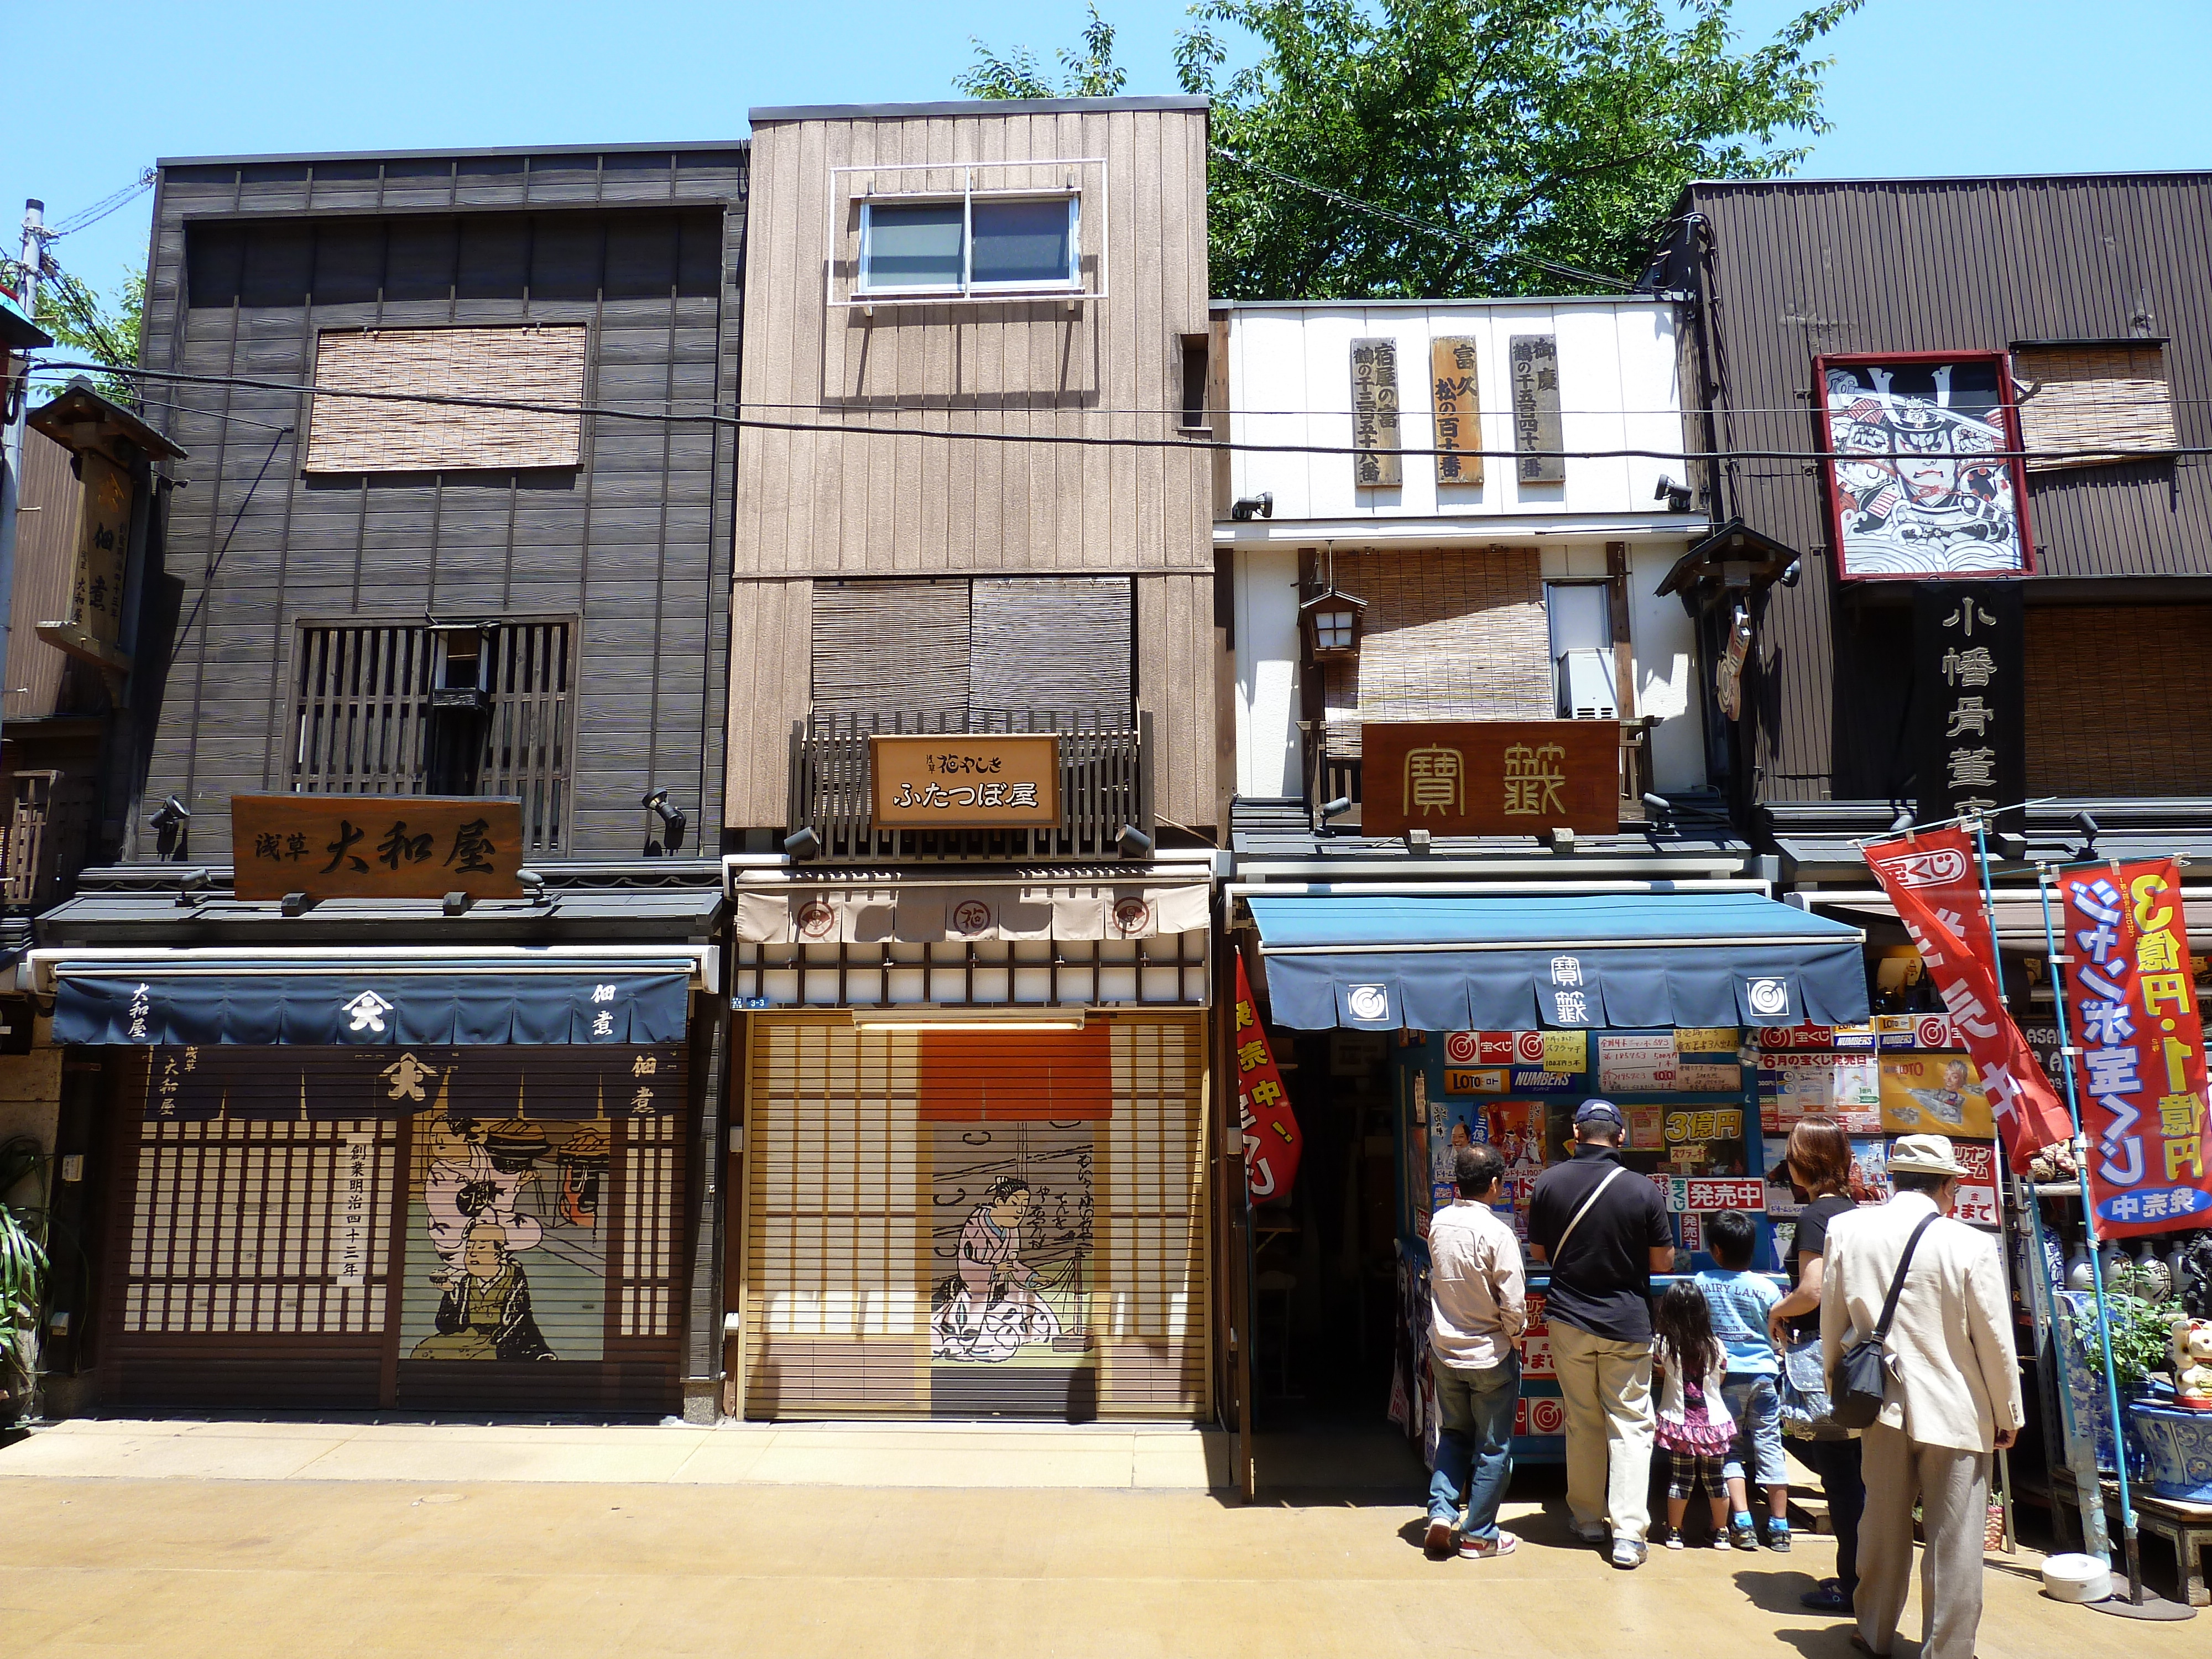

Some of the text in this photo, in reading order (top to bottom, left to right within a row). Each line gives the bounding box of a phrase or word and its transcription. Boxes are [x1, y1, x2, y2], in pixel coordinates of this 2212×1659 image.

[1453, 344, 1477, 398] 富久
[1533, 338, 1556, 392] 御慶
[1374, 342, 1397, 429] 宿屋の富
[893, 782, 1040, 808] ふたつぼ屋
[255, 817, 495, 875] 浅草 大和屋
[128, 983, 150, 1038] 大和屋
[591, 984, 617, 1036] 佃煮
[1883, 1019, 1898, 1029] LOTO
[1480, 1041, 1512, 1052] 宝くじ
[1795, 1030, 1829, 1042] 宝くじ
[1837, 1037, 1873, 1046] NUMBERS
[1453, 1073, 1481, 1090] LOTO
[1515, 1072, 1571, 1087] NUMBERS
[1900, 1062, 1924, 1076] LOTO
[159, 1054, 179, 1116] 大和屋
[630, 1055, 658, 1114] 佃煮
[1472, 1118, 1488, 1144] 三億
[1666, 1109, 1742, 1142] 3億円
[1672, 1148, 1706, 1160] スクラッチ
[1672, 1180, 1686, 1211] 宝くじ
[1691, 1183, 1761, 1207] 発売中
[343, 1144, 367, 1277] 創業明治四十三年
[1683, 1215, 1698, 1249] 発売中
[1734, 1286, 1766, 1300] LAND
